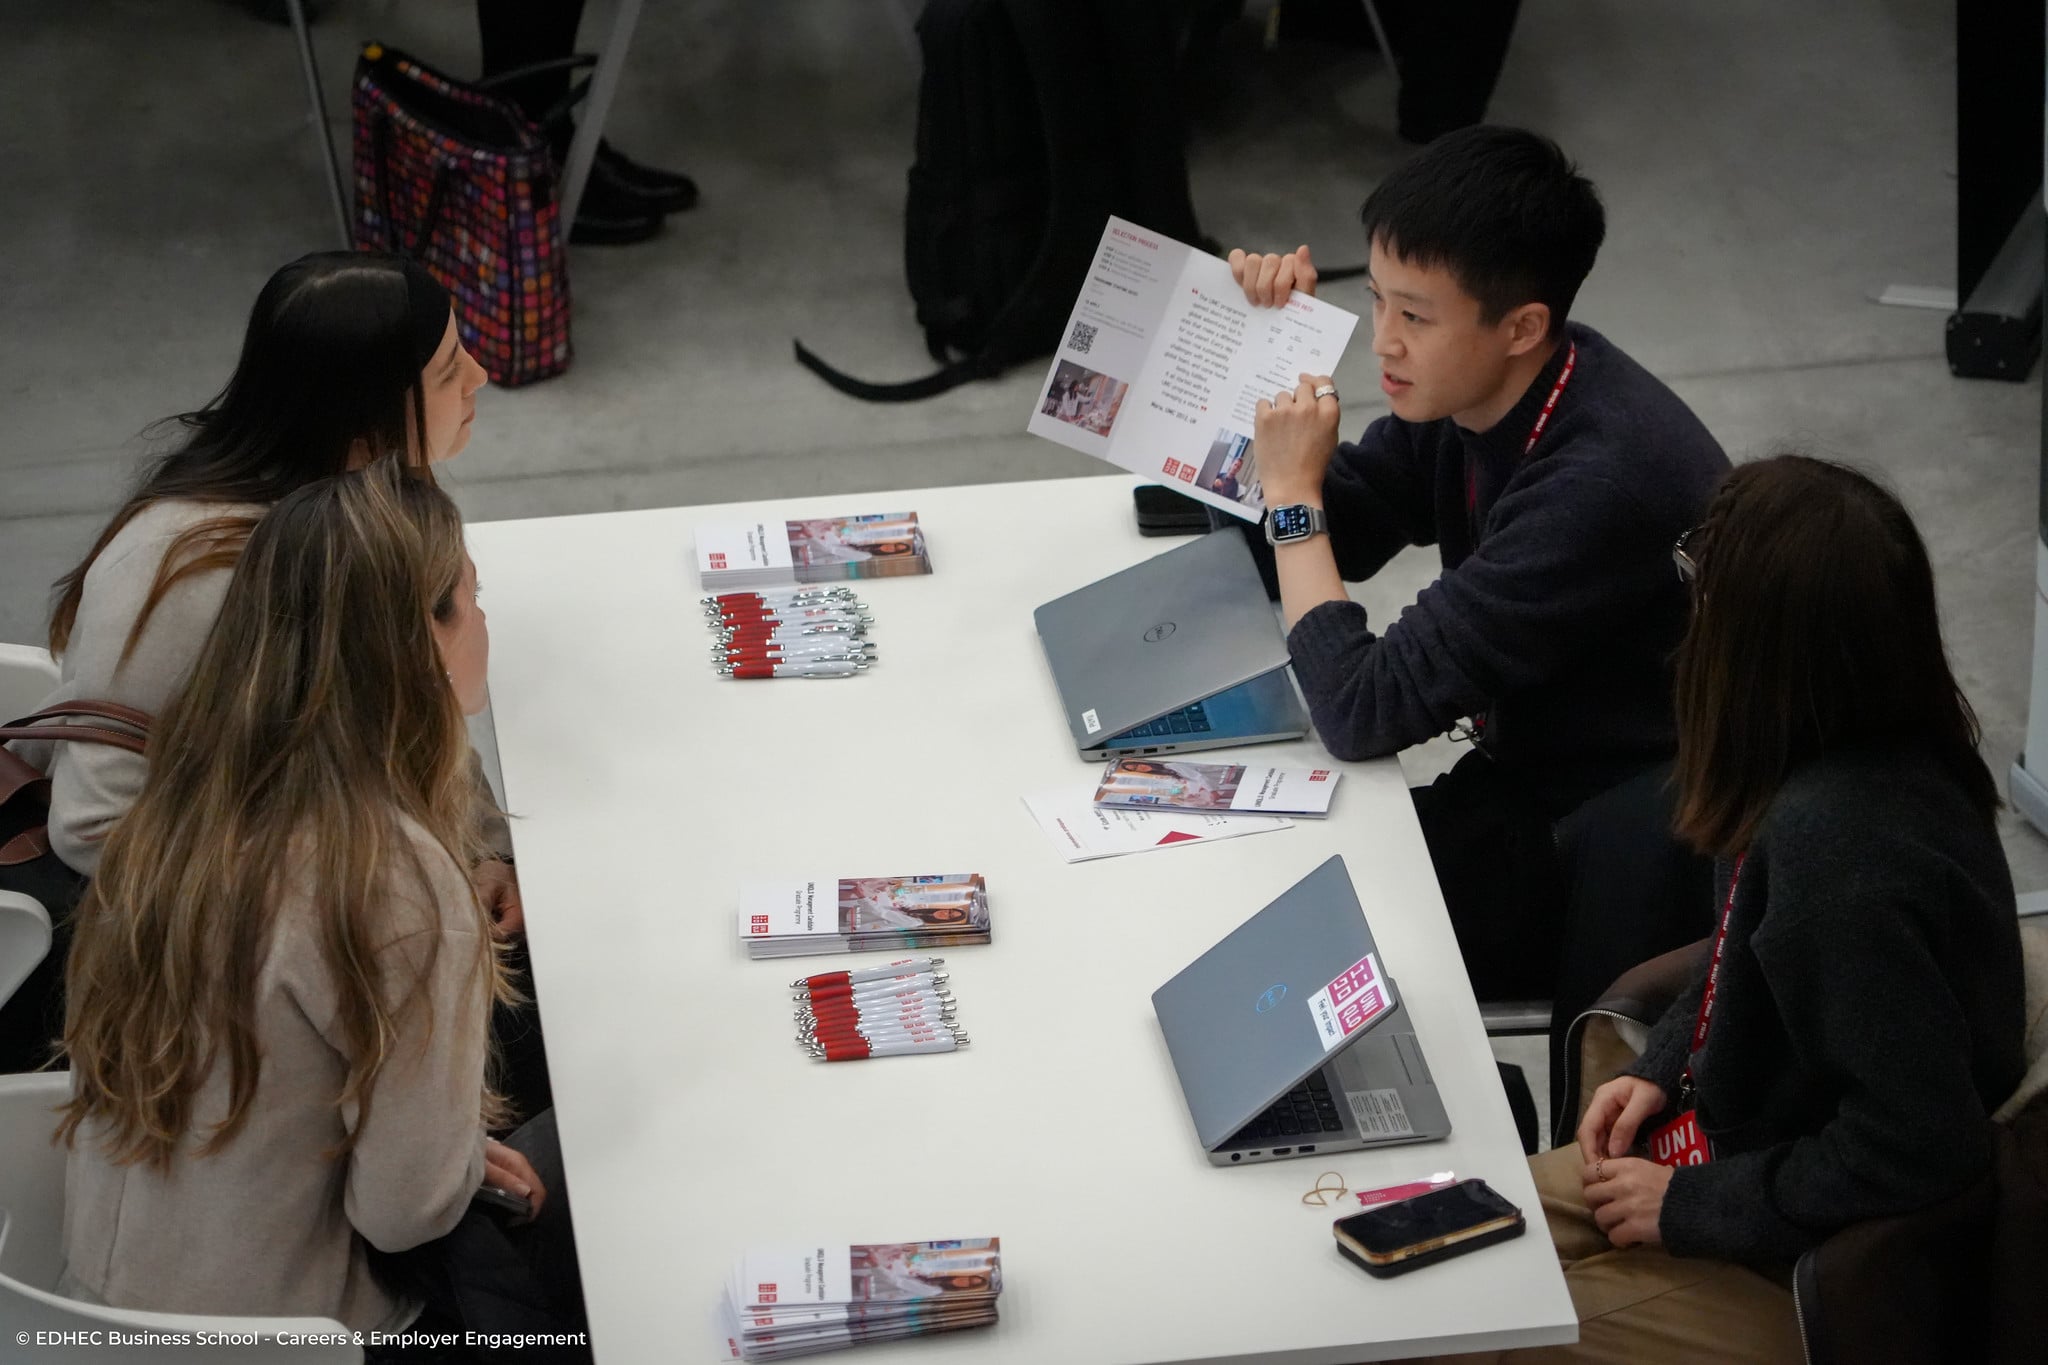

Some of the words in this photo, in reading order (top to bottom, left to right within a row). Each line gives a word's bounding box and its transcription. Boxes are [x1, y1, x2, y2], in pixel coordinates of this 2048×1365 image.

[1342, 1003, 1362, 1029] QLO
[1360, 991, 1378, 1016] UNI
[1657, 1120, 1696, 1160] UNI
